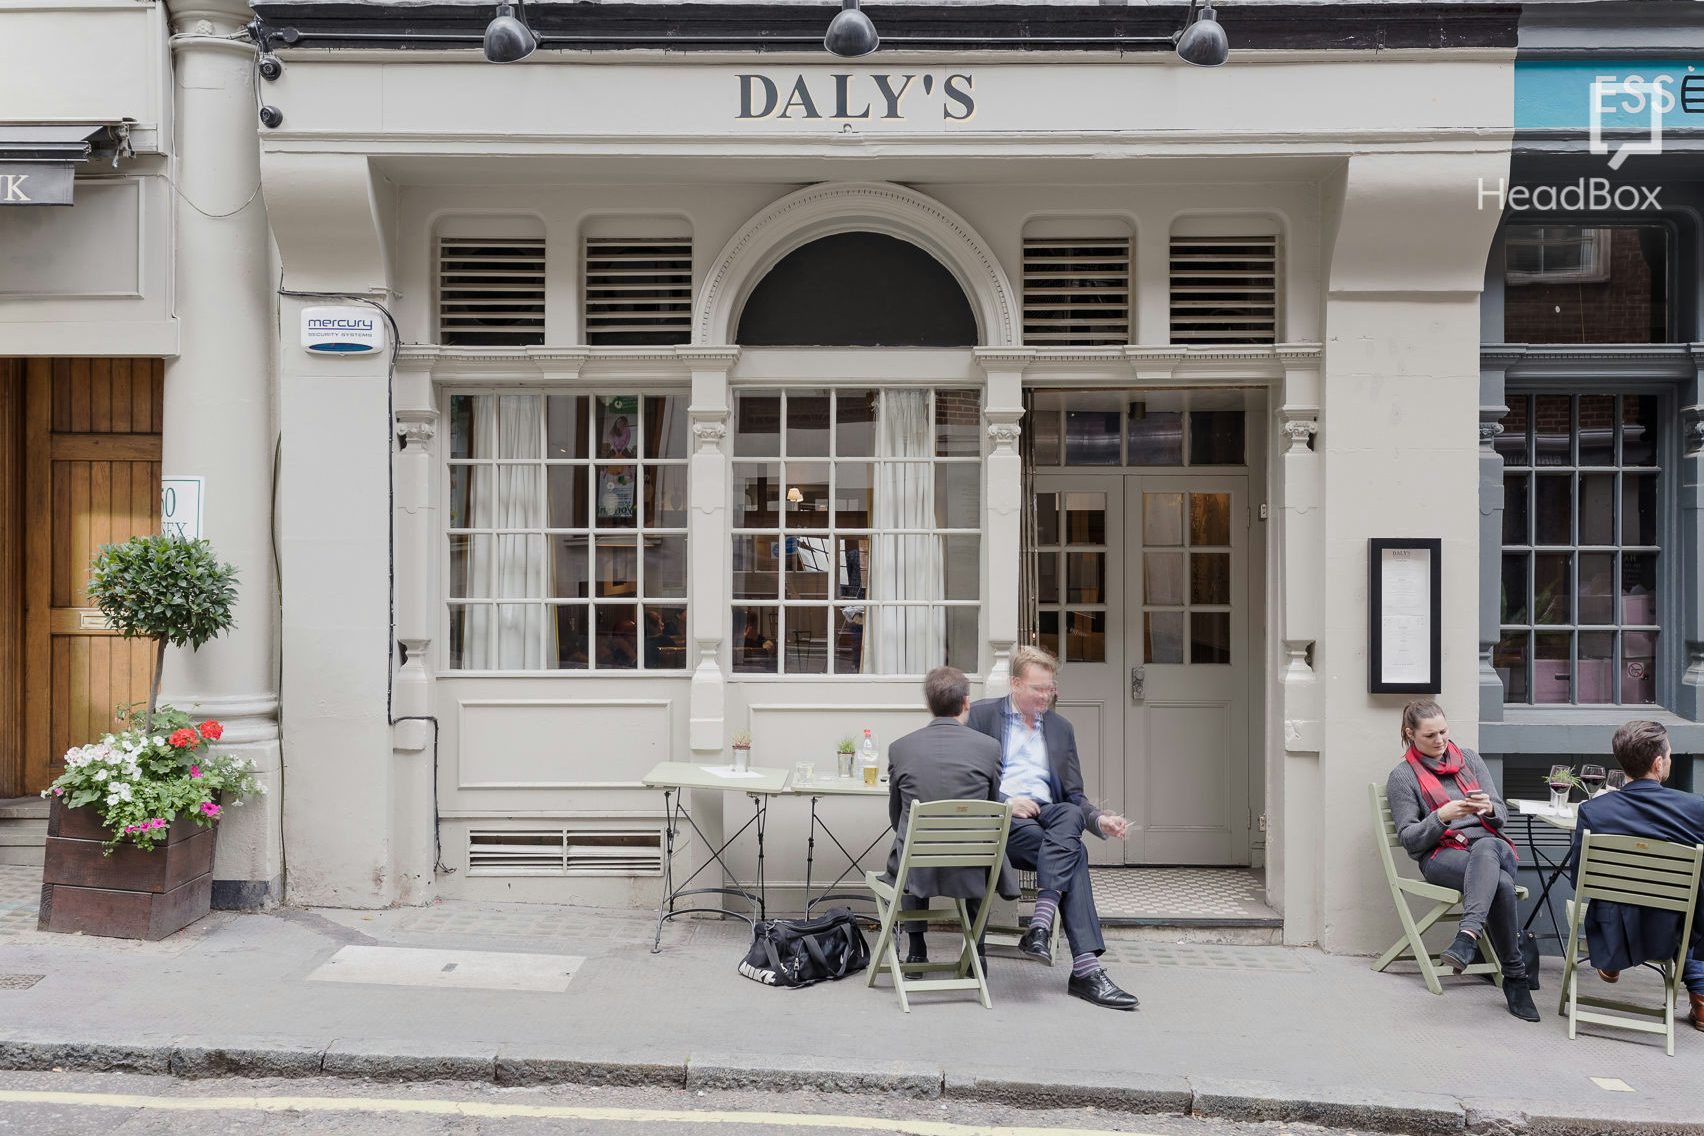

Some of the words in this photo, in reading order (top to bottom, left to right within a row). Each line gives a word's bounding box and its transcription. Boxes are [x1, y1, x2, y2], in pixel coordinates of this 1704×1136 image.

[734, 73, 976, 121] DALY'S
[308, 319, 373, 331] mercury
[739, 960, 776, 985] NIKE
